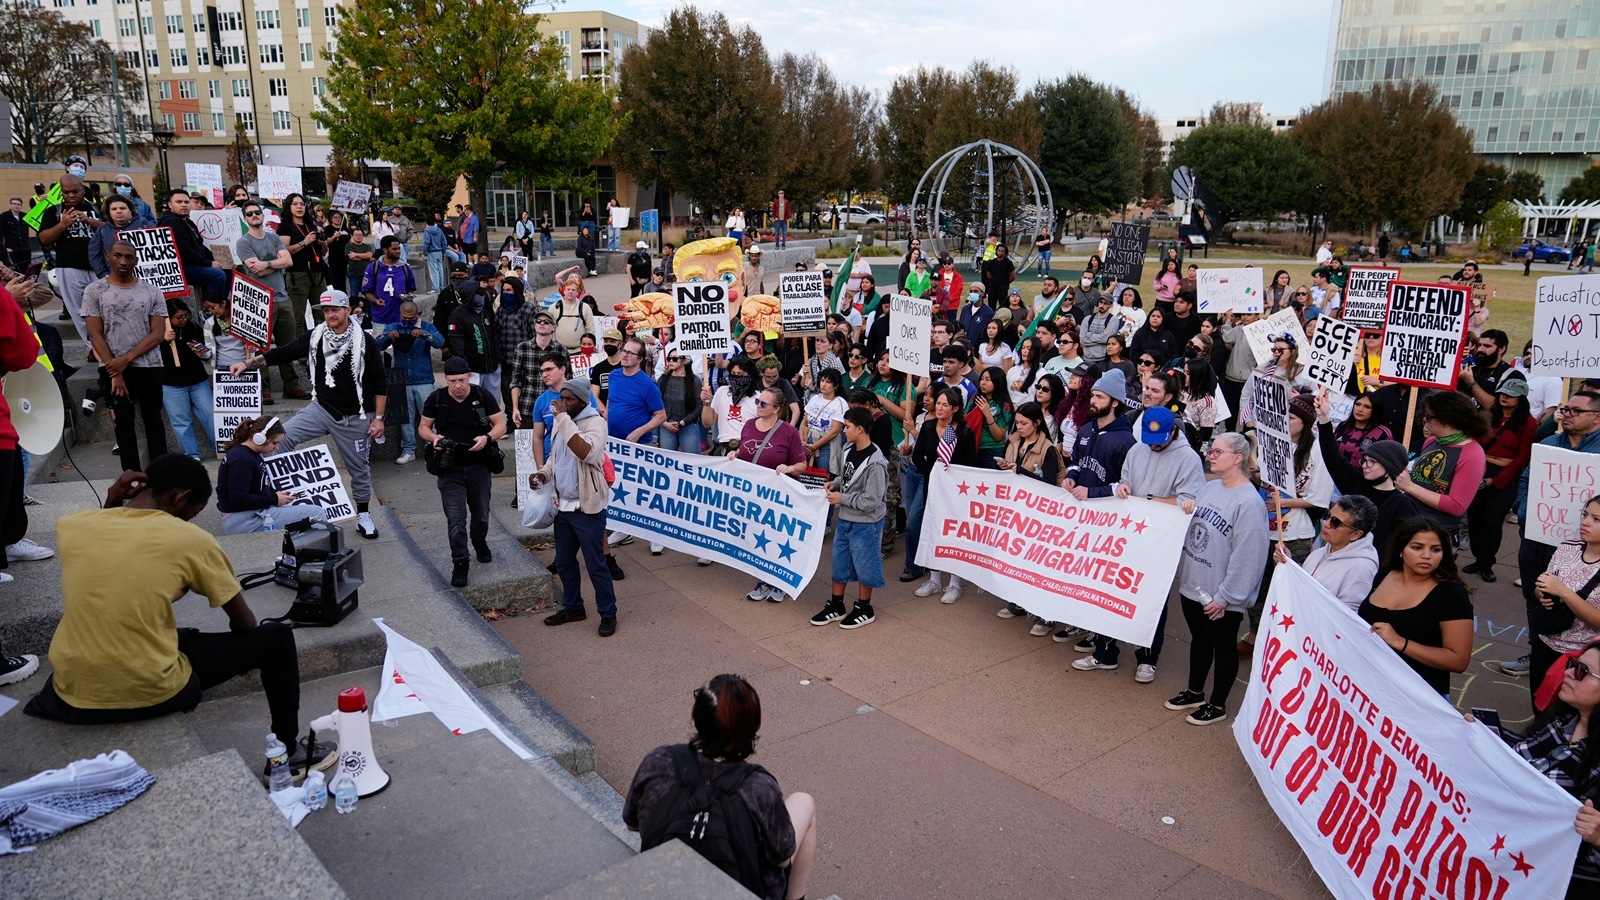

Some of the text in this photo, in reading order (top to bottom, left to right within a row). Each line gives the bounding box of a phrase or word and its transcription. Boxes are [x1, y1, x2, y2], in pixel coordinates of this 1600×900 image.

[147, 228, 173, 243] THE
[203, 217, 220, 236] NO
[1111, 224, 1141, 239] NO ONE
[137, 244, 177, 262] TACKS
[1106, 248, 1116, 259] ON
[1108, 238, 1144, 252] IS ILLEGAL
[157, 262, 180, 275] OUR
[782, 275, 804, 284] ¡PODER
[1200, 271, 1219, 284] Keep
[1351, 271, 1397, 280] THE PEOPLE
[234, 281, 270, 305] ¡DINERO
[383, 277, 394, 297] 4
[677, 285, 724, 303] NO
[782, 282, 822, 292] LA CLASE
[1350, 279, 1390, 291] UNITE
[1539, 282, 1600, 306] Educatio
[232, 294, 269, 322] PUEBLO,
[678, 303, 725, 316] BORDER
[793, 307, 810, 315] PARA
[811, 306, 823, 314] LOS
[890, 296, 932, 318] COMPASSION
[1346, 301, 1386, 310] IMMIGRAN
[1392, 285, 1464, 316] DEFEND
[232, 307, 268, 333] NO PARA
[1344, 310, 1386, 320] FAMILIES
[1388, 310, 1461, 334] DEMOCRACY:
[231, 317, 240, 327] LA
[240, 321, 268, 341] GUERRA!
[681, 321, 724, 334] PATROL
[900, 323, 918, 341] OVER
[1317, 317, 1353, 347] ICE
[680, 337, 728, 351] CHARLOTTE!
[1316, 334, 1350, 361] OUT
[1385, 331, 1458, 355] IT'S TIME FOR
[893, 348, 920, 365] CAGES
[1310, 352, 1325, 363] OF
[1326, 359, 1346, 374] OUR
[1389, 347, 1446, 369] A GENERAL
[1308, 365, 1348, 392] CITY
[1395, 362, 1438, 382] STRIKE!
[223, 385, 258, 394] WORKERS'
[1254, 375, 1287, 416] DEFEND
[216, 397, 259, 408] STRUGGLE
[223, 416, 239, 426] HAS
[1256, 406, 1289, 435] DEMOCRACY:
[1266, 432, 1279, 451] TIME
[1278, 436, 1291, 460] FOR
[266, 449, 330, 478] TRUMP:
[1266, 449, 1289, 476] GENERAL
[272, 466, 336, 491] END
[634, 447, 693, 475] PEOPLE
[697, 466, 751, 493] UNITED
[756, 484, 794, 508] WILL
[1267, 463, 1287, 490] STRIKE!
[1542, 462, 1596, 487] THIS
[307, 482, 341, 495] WAR
[611, 458, 812, 541] FEND IMMIGRANT
[1540, 481, 1595, 504] IS FOR
[635, 487, 748, 540] FAMILIES!
[995, 484, 1118, 529] EL PUEBLO UNIDO
[1537, 502, 1574, 525] OUR
[608, 508, 619, 517] OR
[620, 512, 662, 529] SOCIALISM
[663, 523, 678, 535] AND
[680, 530, 724, 549] LIBERATION
[969, 501, 1128, 558] DEFENDERÁ A LAS
[938, 548, 964, 558] PARTY
[964, 552, 977, 560] FOR
[1003, 566, 1036, 583] LIBERATION
[942, 519, 1145, 595] FAMILIAS MIGRANTES!
[1260, 629, 1298, 693] ICE
[1279, 666, 1312, 715] &
[1304, 682, 1398, 818] BORDER
[1302, 635, 1473, 823] CHARLOTTE DEMANDS:
[1252, 697, 1302, 770] OUT
[1285, 744, 1329, 806] OF
[1317, 780, 1382, 878] OUR
